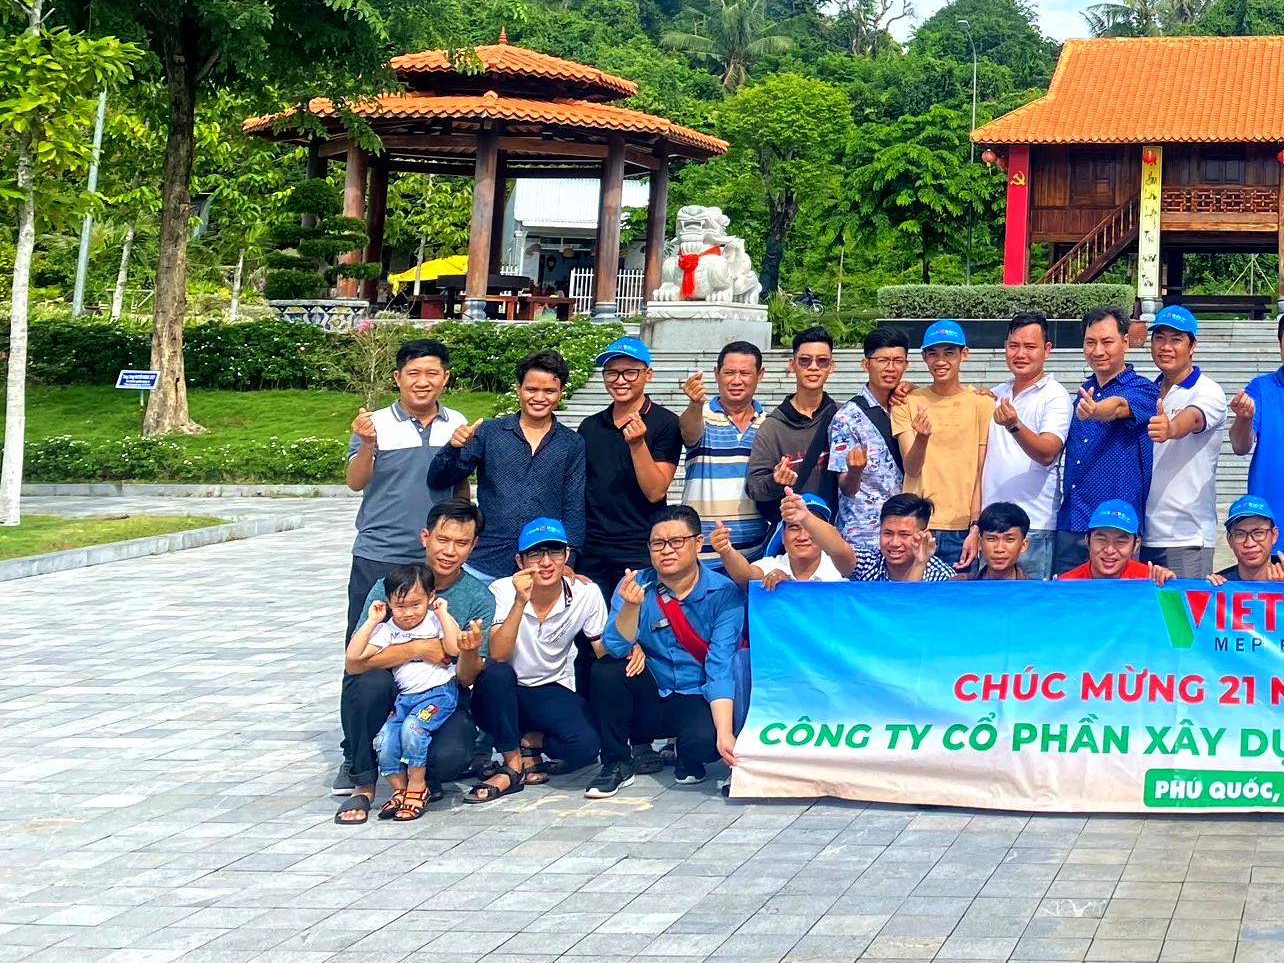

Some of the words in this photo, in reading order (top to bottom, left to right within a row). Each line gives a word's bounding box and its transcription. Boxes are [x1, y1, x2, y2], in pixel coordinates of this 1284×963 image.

[1214, 637, 1264, 652] MEP
[953, 665, 1066, 702] CHÚC
[1080, 665, 1205, 704] MỪNG
[1218, 675, 1255, 705] 21
[759, 715, 872, 749] CÔNG
[885, 723, 933, 750] TY
[942, 712, 998, 752] CỔ
[1011, 713, 1130, 755] PHẦN
[1143, 718, 1227, 756] XÂY
[1154, 776, 1201, 799] PHÚ
[1208, 776, 1282, 803] QUỐC,
